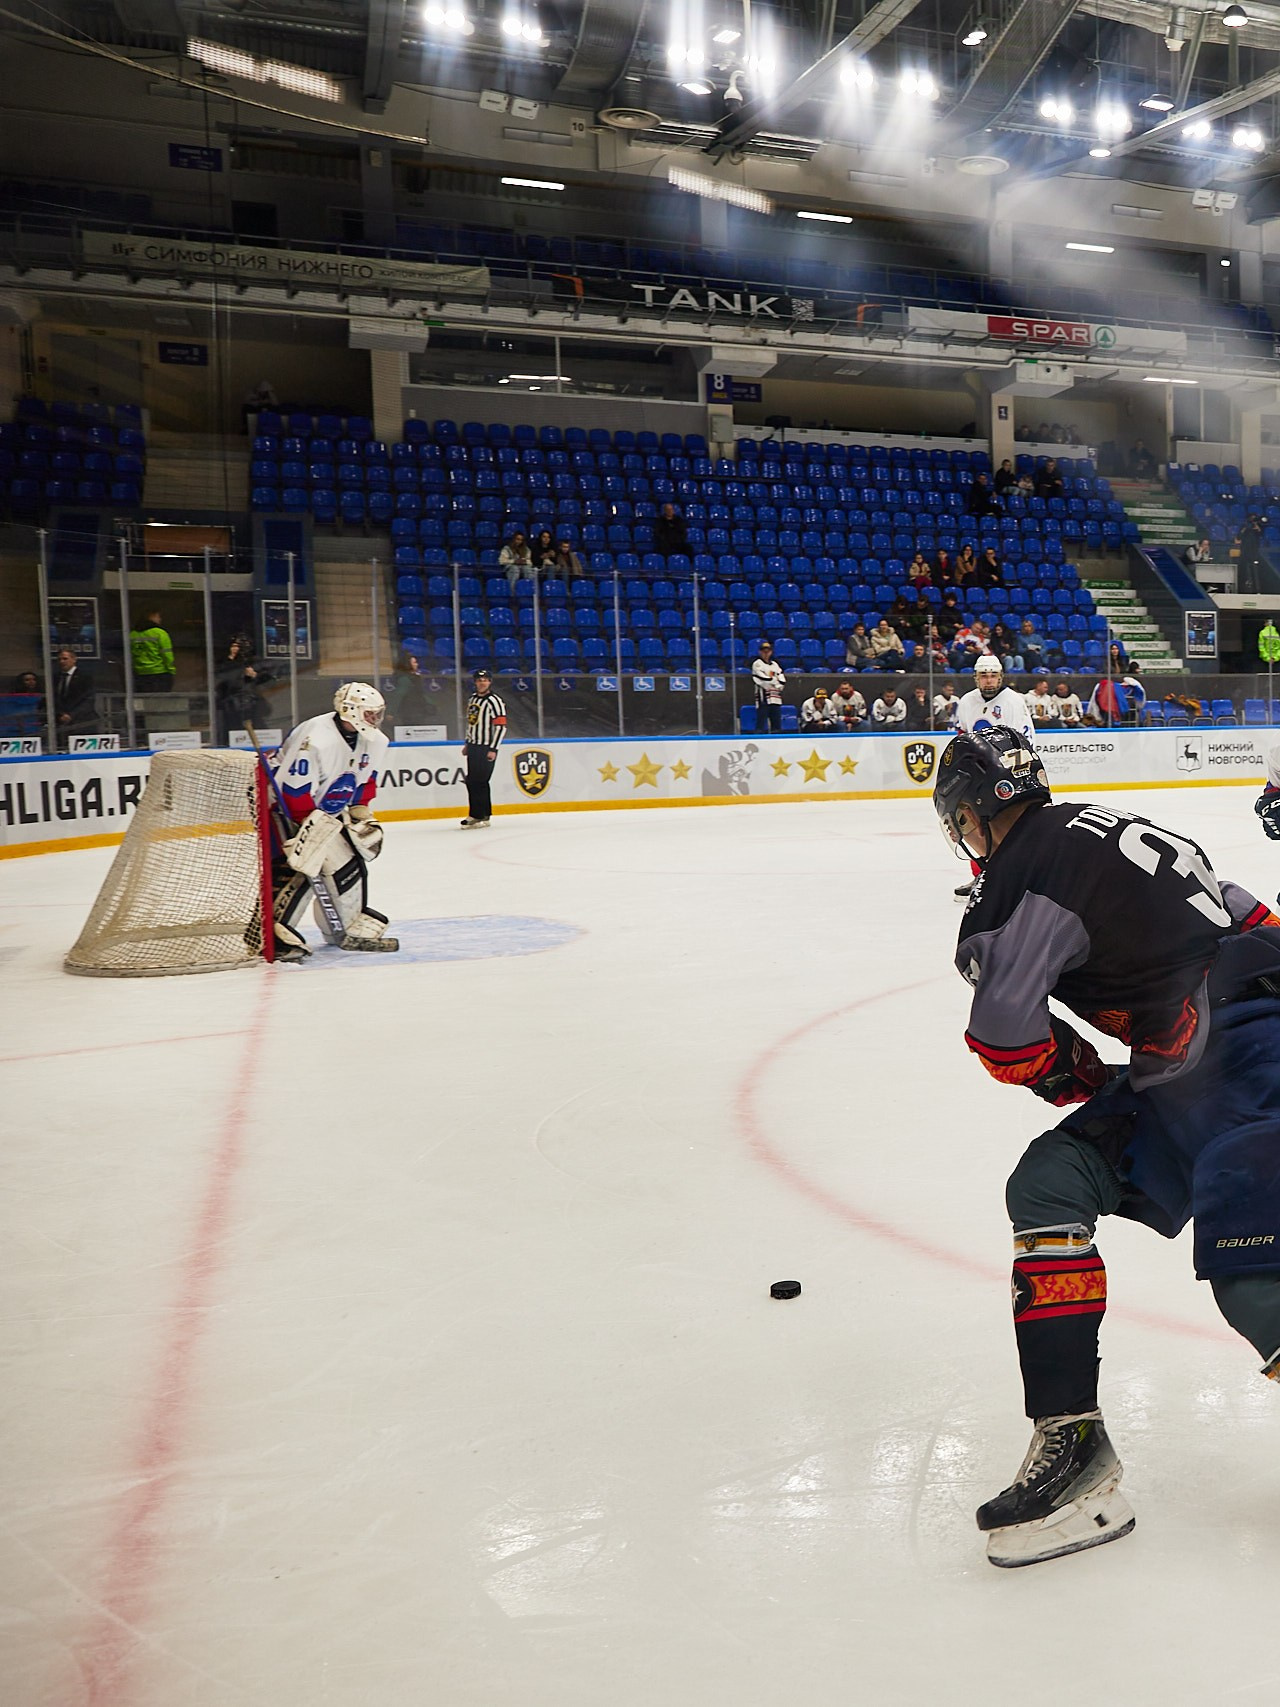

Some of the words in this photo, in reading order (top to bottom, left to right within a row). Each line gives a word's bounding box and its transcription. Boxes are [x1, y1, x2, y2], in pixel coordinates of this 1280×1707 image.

[572, 122, 584, 132] 10
[145, 245, 267, 269] СИМФОНИЯ
[278, 258, 373, 279] НИЖНЕГО
[630, 283, 780, 319] TANK
[1012, 321, 1088, 343] SPAR
[714, 373, 724, 390] 8
[0, 741, 37, 754] PARI
[74, 738, 115, 751] PARI
[1035, 743, 1115, 753] РАВИТЕЛЬСТВО
[1208, 741, 1254, 752] НИЖНИЙ
[288, 758, 309, 776] 40
[1208, 755, 1264, 766] НОВГОРОД
[1215, 1235, 1275, 1249] BAUER
